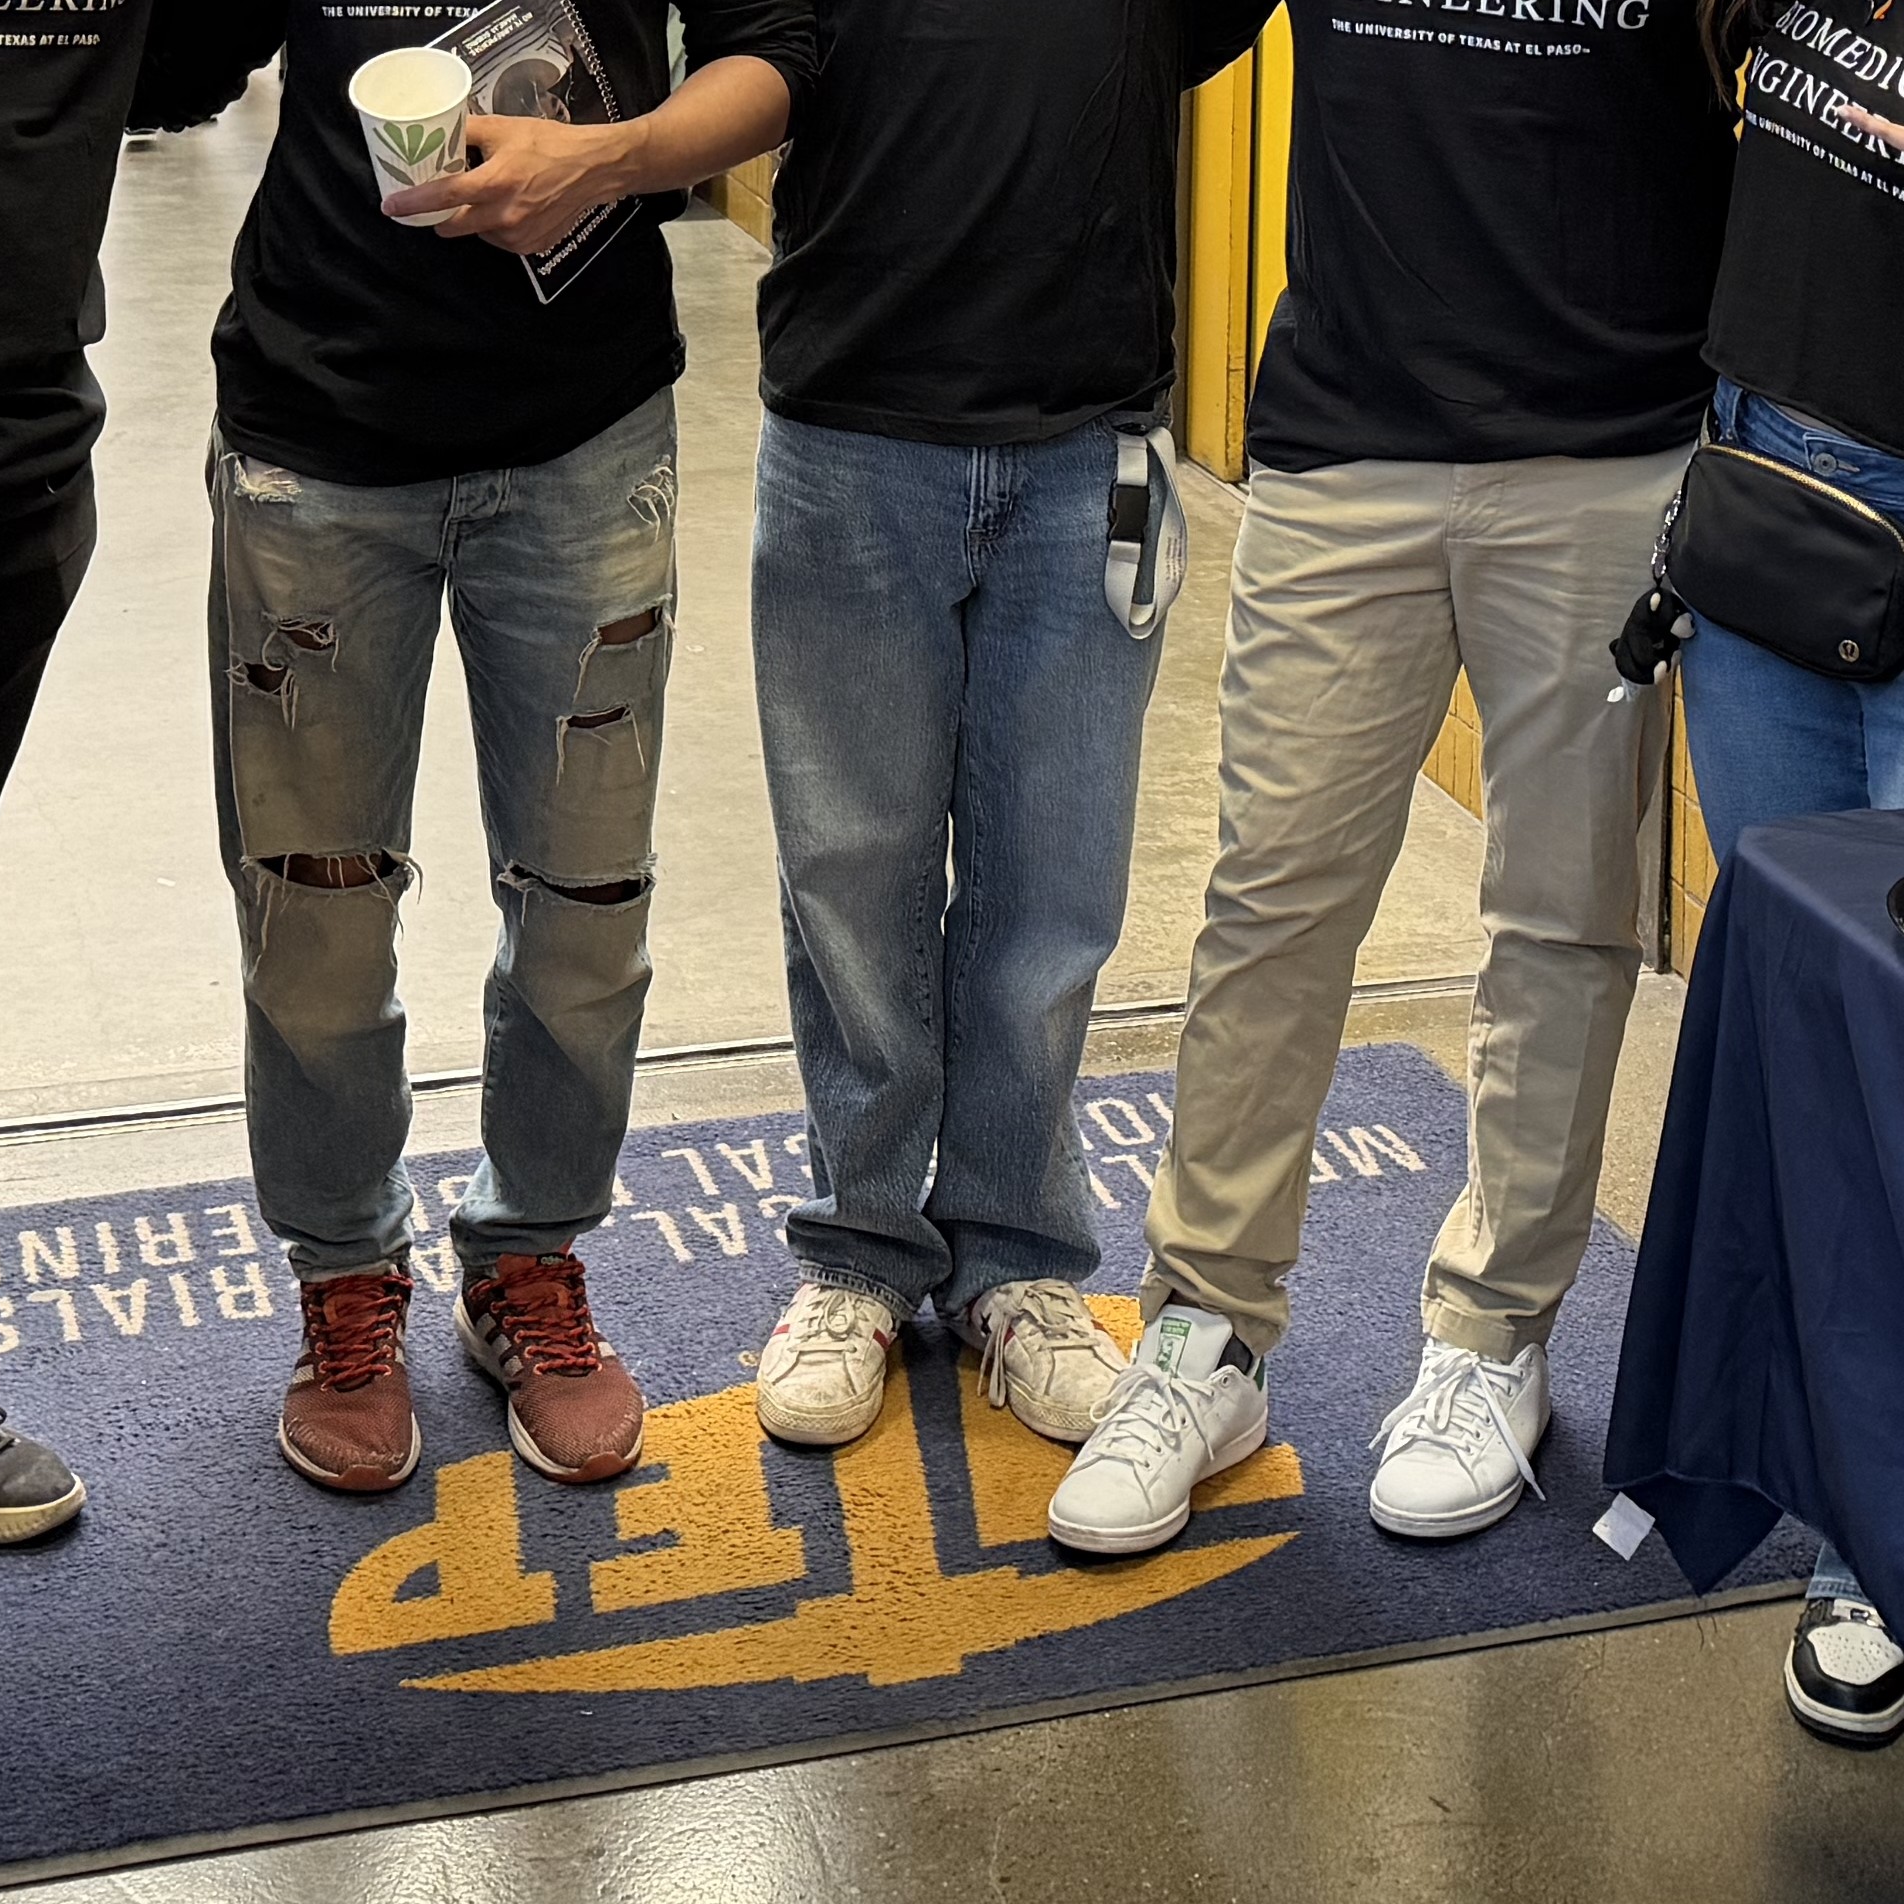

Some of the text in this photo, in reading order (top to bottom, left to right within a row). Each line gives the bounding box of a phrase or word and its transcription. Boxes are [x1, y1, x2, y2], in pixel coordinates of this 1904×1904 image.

[321, 6, 478, 18] THE UNIVERSITY OF TEXA
[39, 34, 55, 46] AT
[57, 35, 70, 46] EL
[72, 34, 100, 46] PASO
[1331, 18, 1582, 56] THE UNIVERSITY OF TEXAS AT EL PASO
[1746, 109, 1757, 125] THE
[1759, 116, 1811, 152] UNIVERSITY
[1813, 144, 1826, 159] OF
[1828, 153, 1858, 177] TEXAS
[1861, 170, 1873, 185] AT
[1877, 178, 1889, 194] EL
